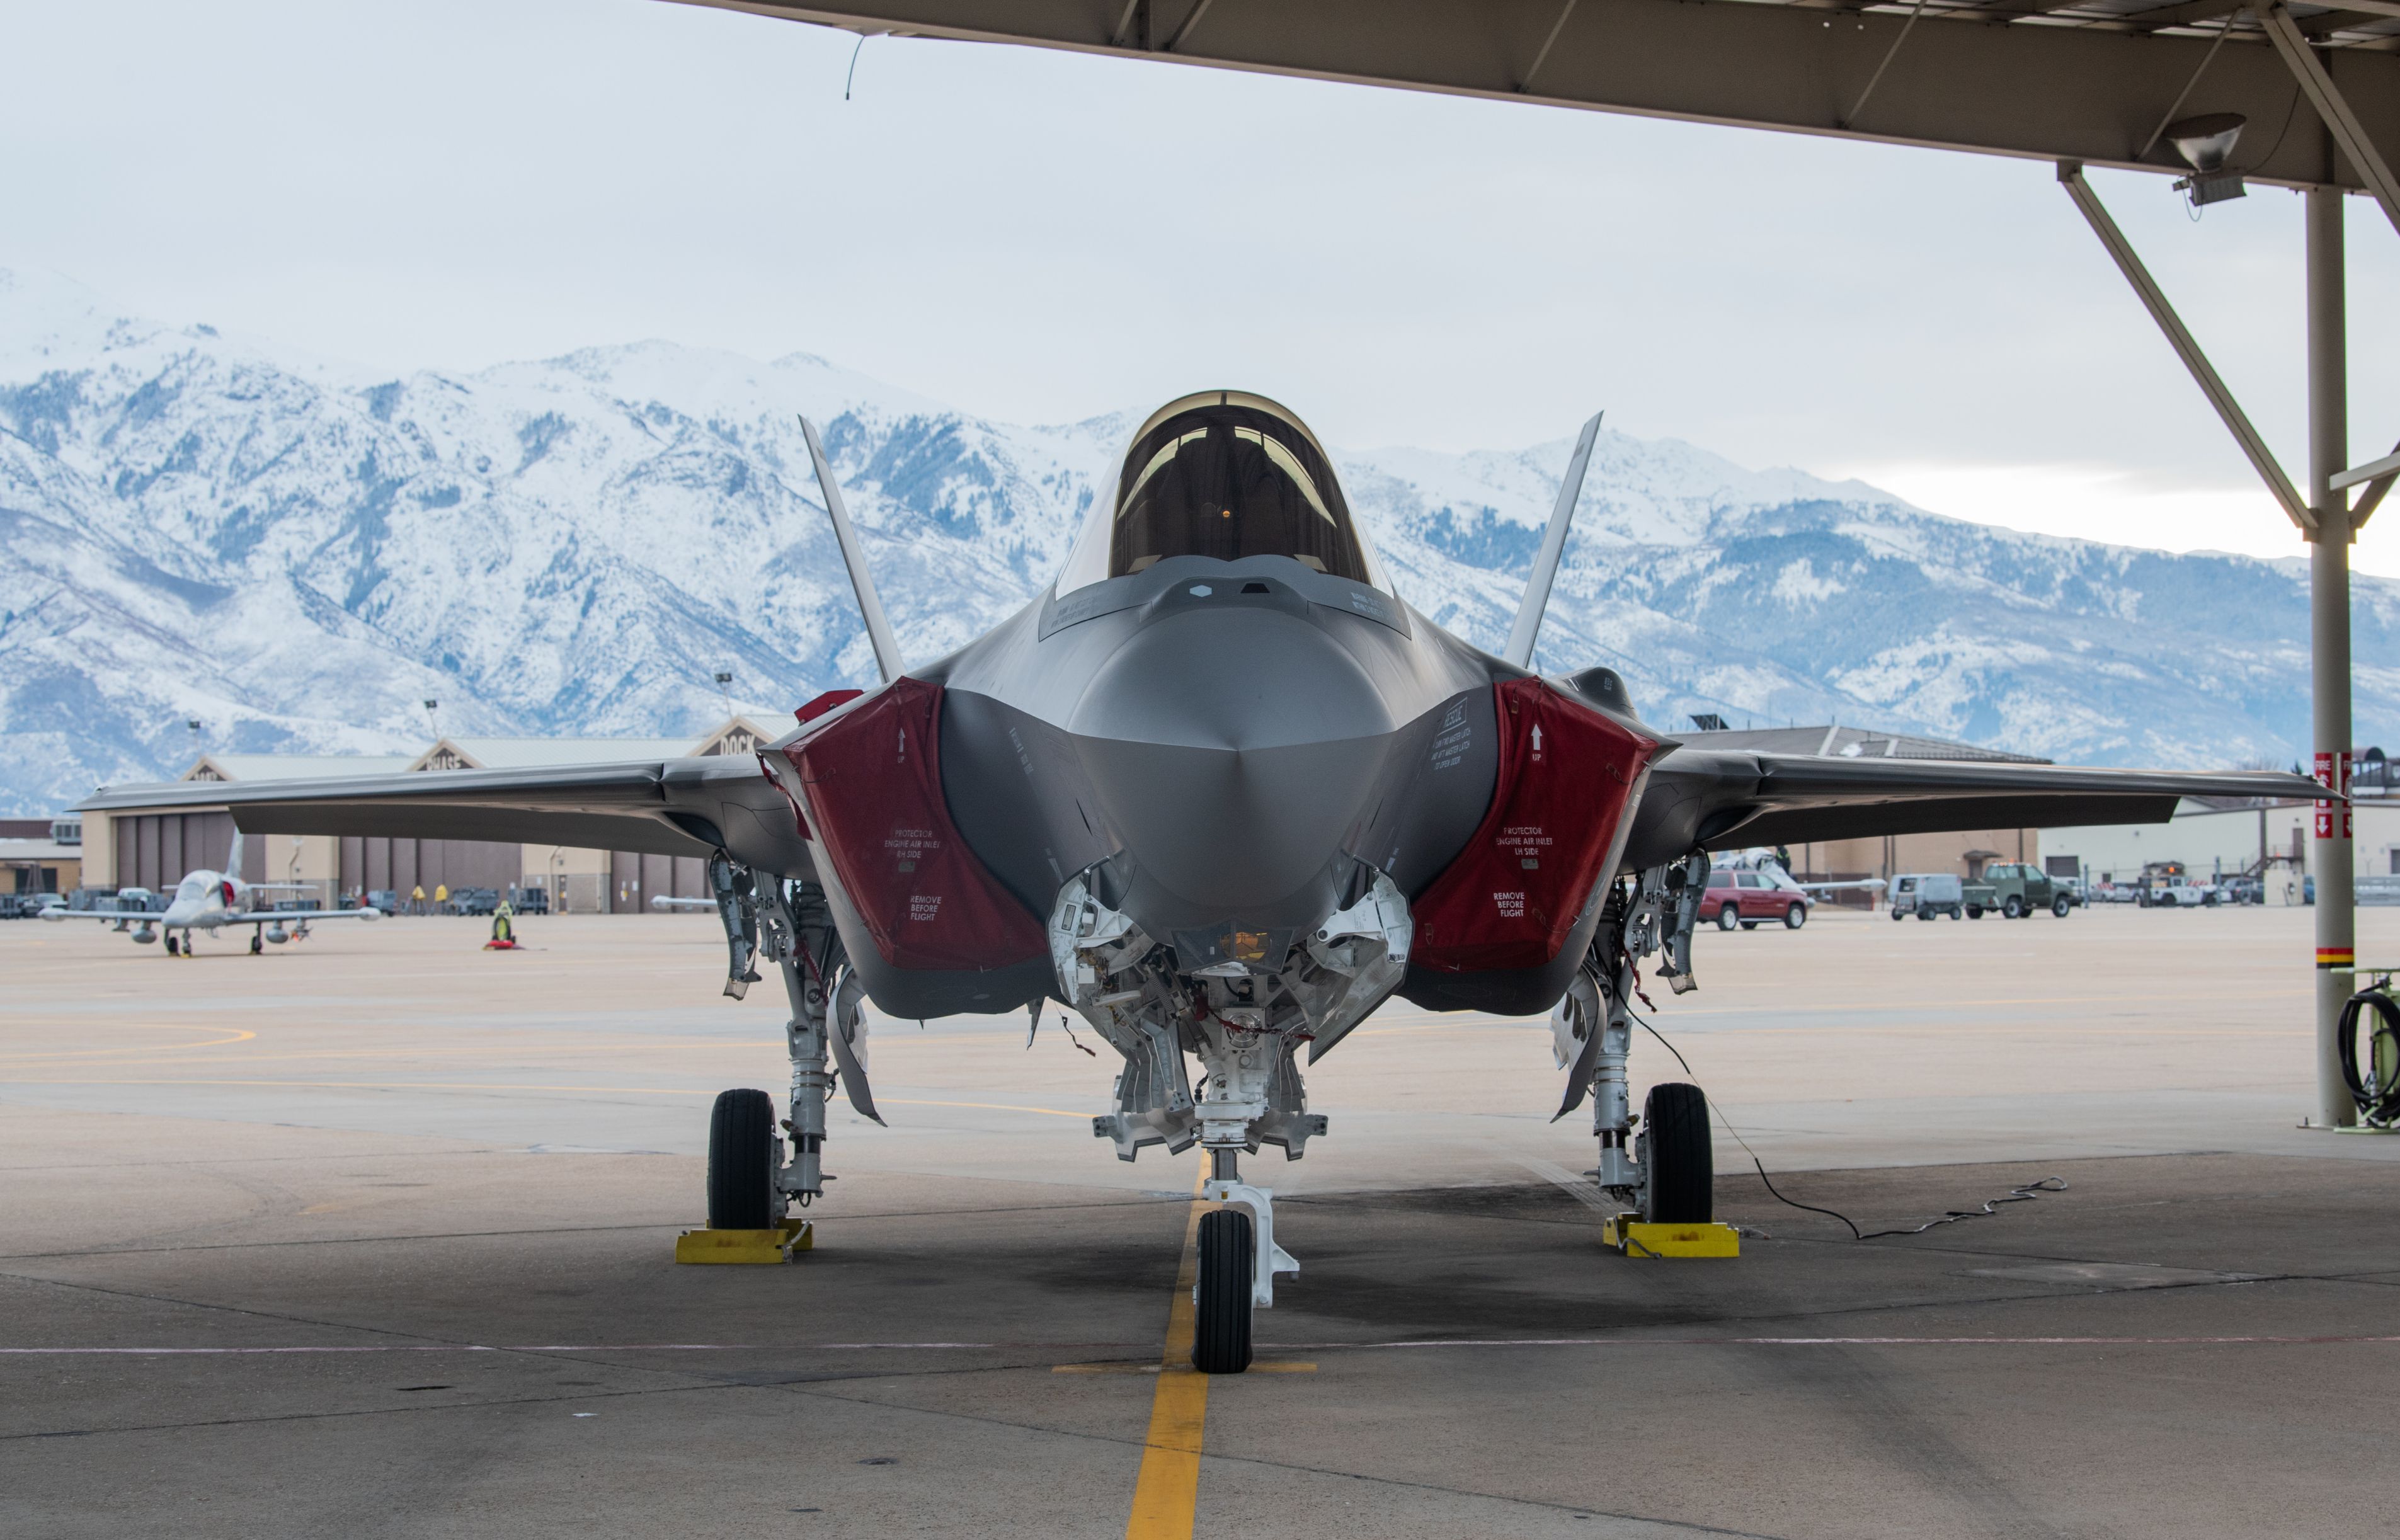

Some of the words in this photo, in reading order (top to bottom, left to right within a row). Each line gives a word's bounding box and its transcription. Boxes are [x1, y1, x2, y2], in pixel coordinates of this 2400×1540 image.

[1443, 705, 1463, 728] RESCUE
[1449, 731, 1461, 744] MASTER
[1461, 727, 1471, 739] LATCH
[720, 734, 756, 756] DOCK
[1446, 744, 1459, 756] MASTER
[1459, 740, 1470, 751] LATCH
[898, 755, 905, 763] UP
[1532, 753, 1541, 761] UP
[426, 755, 461, 770] PHASE
[1440, 759, 1450, 768] OPEN
[1451, 756, 1461, 766] DOOR
[2316, 760, 2331, 770] FIRE
[895, 830, 932, 838] PROTECTOR
[1536, 837, 1553, 845] INLET
[910, 896, 942, 904] REMOVE
[1494, 892, 1525, 900] REMOVE
[911, 904, 938, 913] BEFORE
[910, 913, 935, 921] FLIGHT
